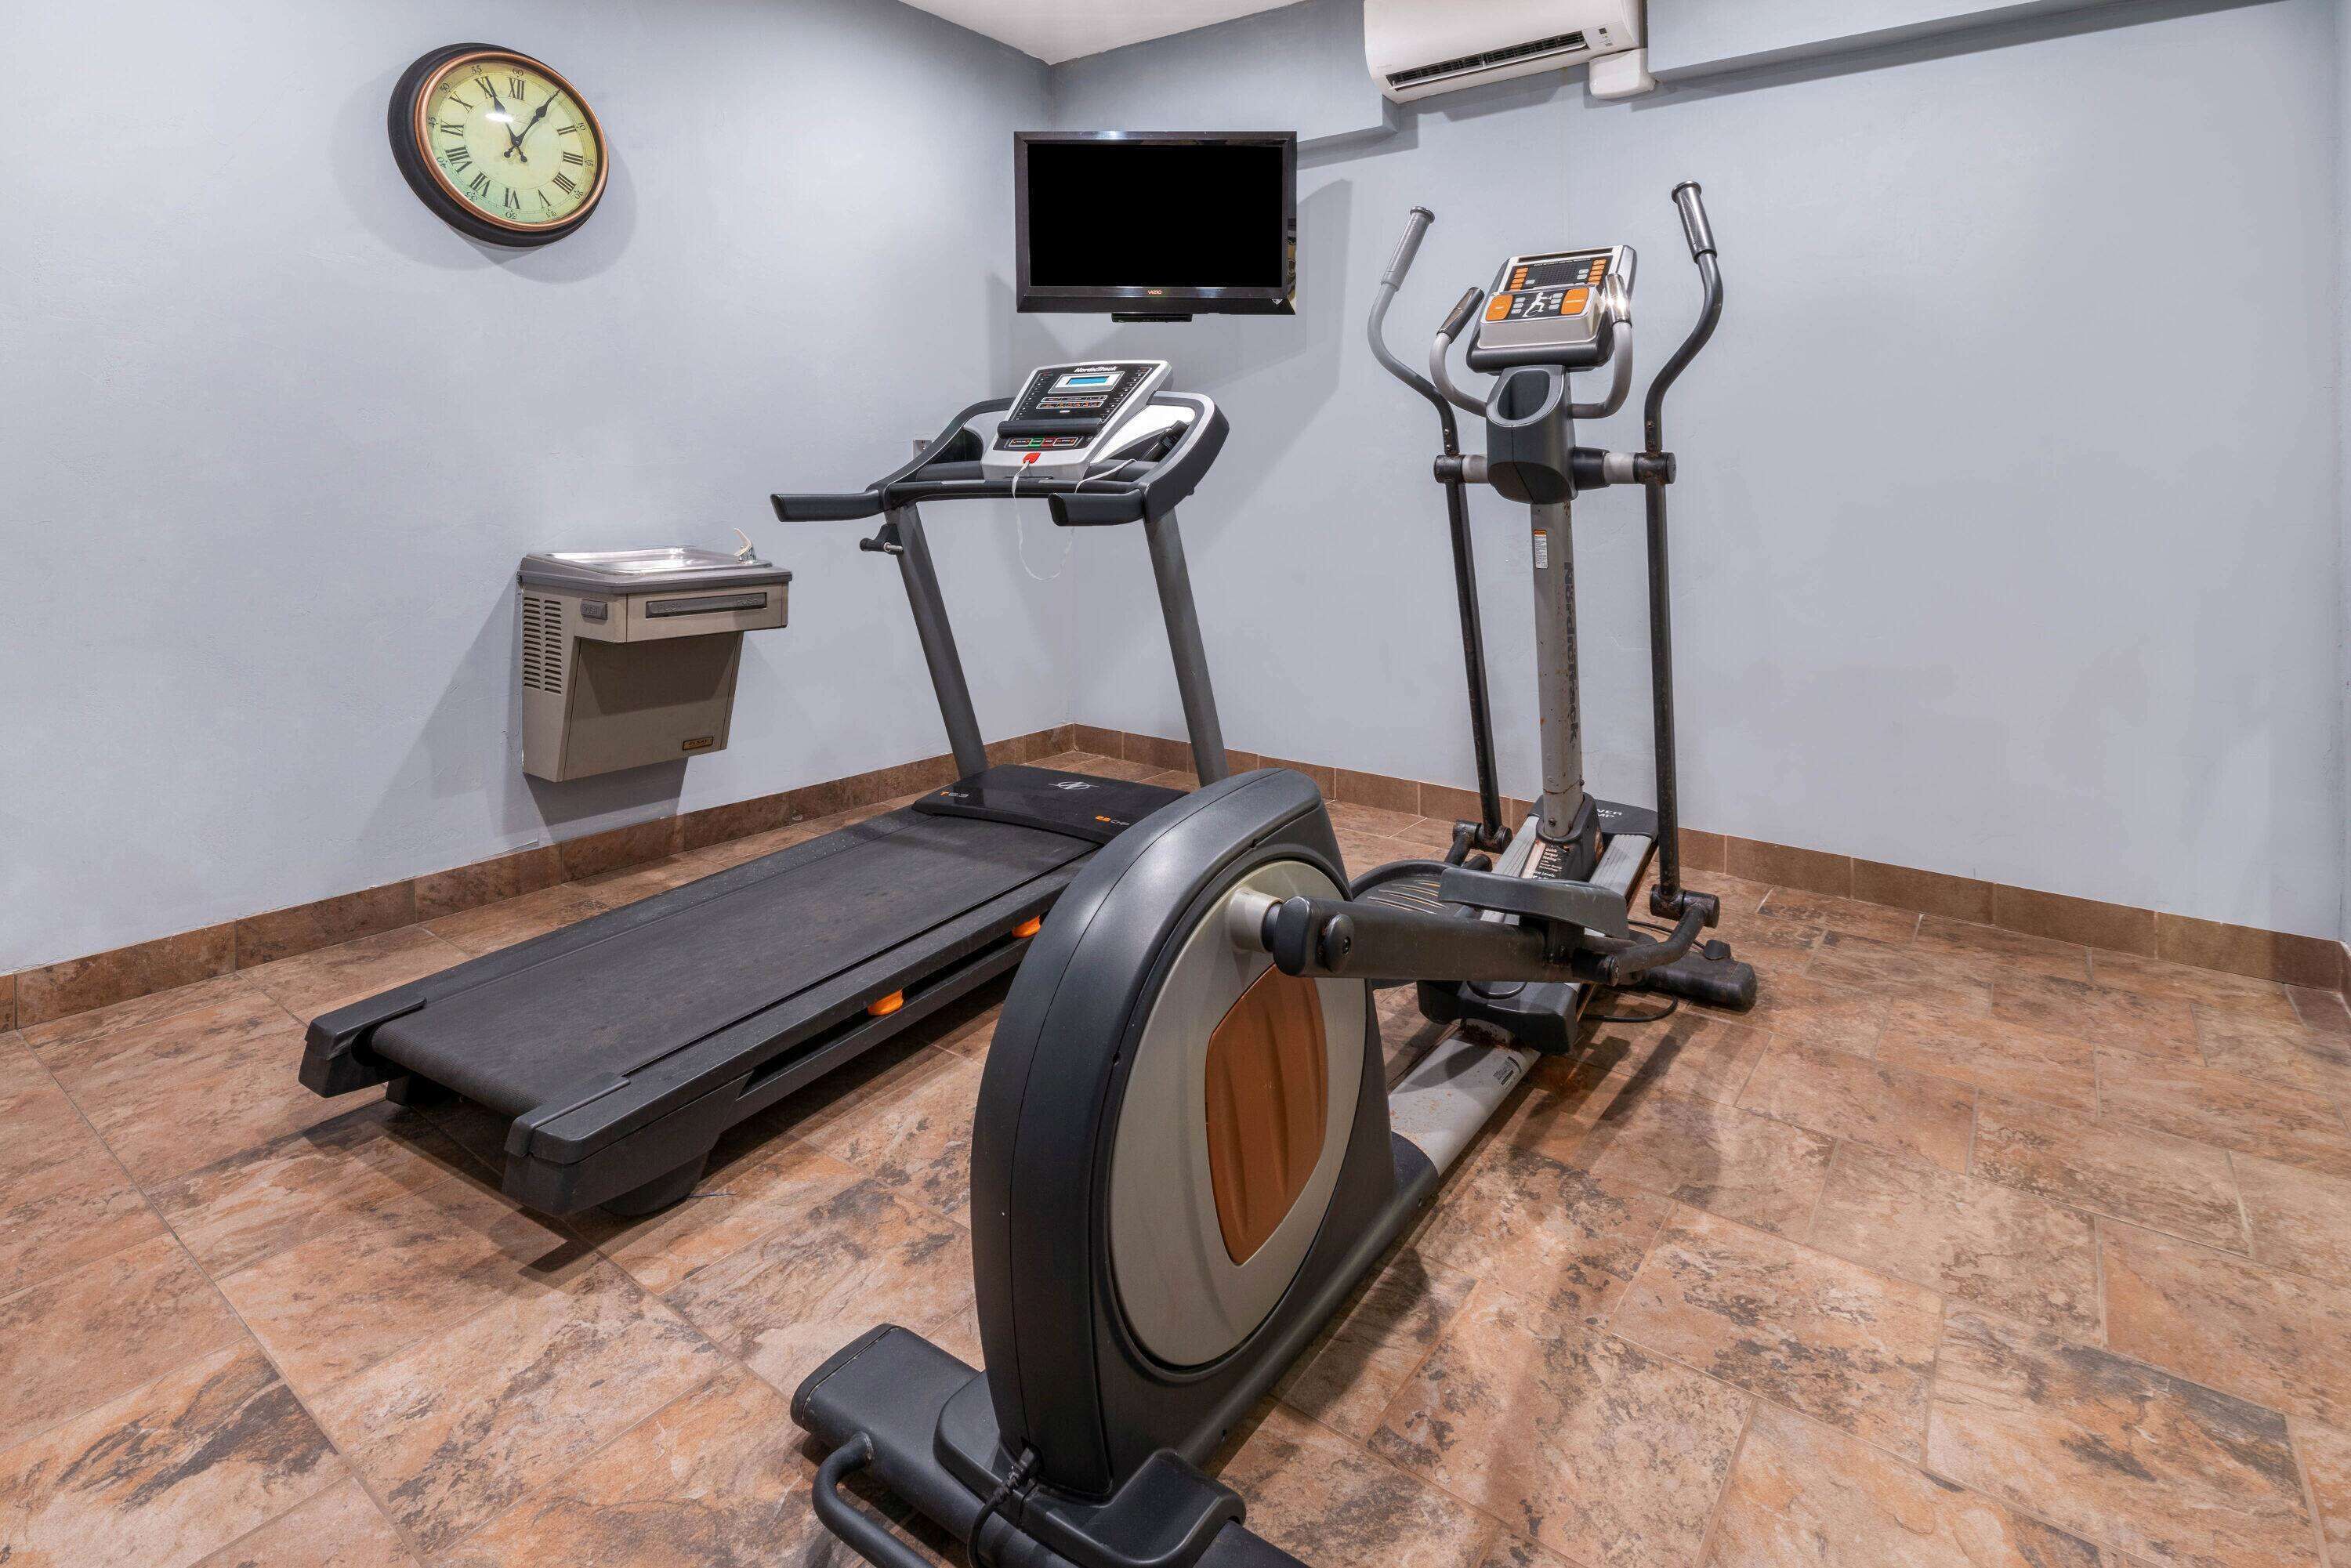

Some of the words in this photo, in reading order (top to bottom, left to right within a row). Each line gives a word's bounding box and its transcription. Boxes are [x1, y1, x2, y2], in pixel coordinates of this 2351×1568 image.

[472, 65, 482, 74] 55
[440, 82, 450, 93] 50
[473, 76, 498, 99] XI
[508, 77, 525, 101] XII
[449, 91, 474, 113] X
[429, 116, 437, 128] 45
[440, 120, 464, 136] IX
[557, 125, 578, 136] II
[578, 122, 586, 131] 10
[444, 145, 473, 173] VIII
[563, 150, 584, 167] III
[469, 172, 491, 198] VII
[552, 172, 578, 195] IIII
[502, 187, 520, 209] VI
[538, 190, 552, 209] V
[657, 602, 683, 612] PUSH
